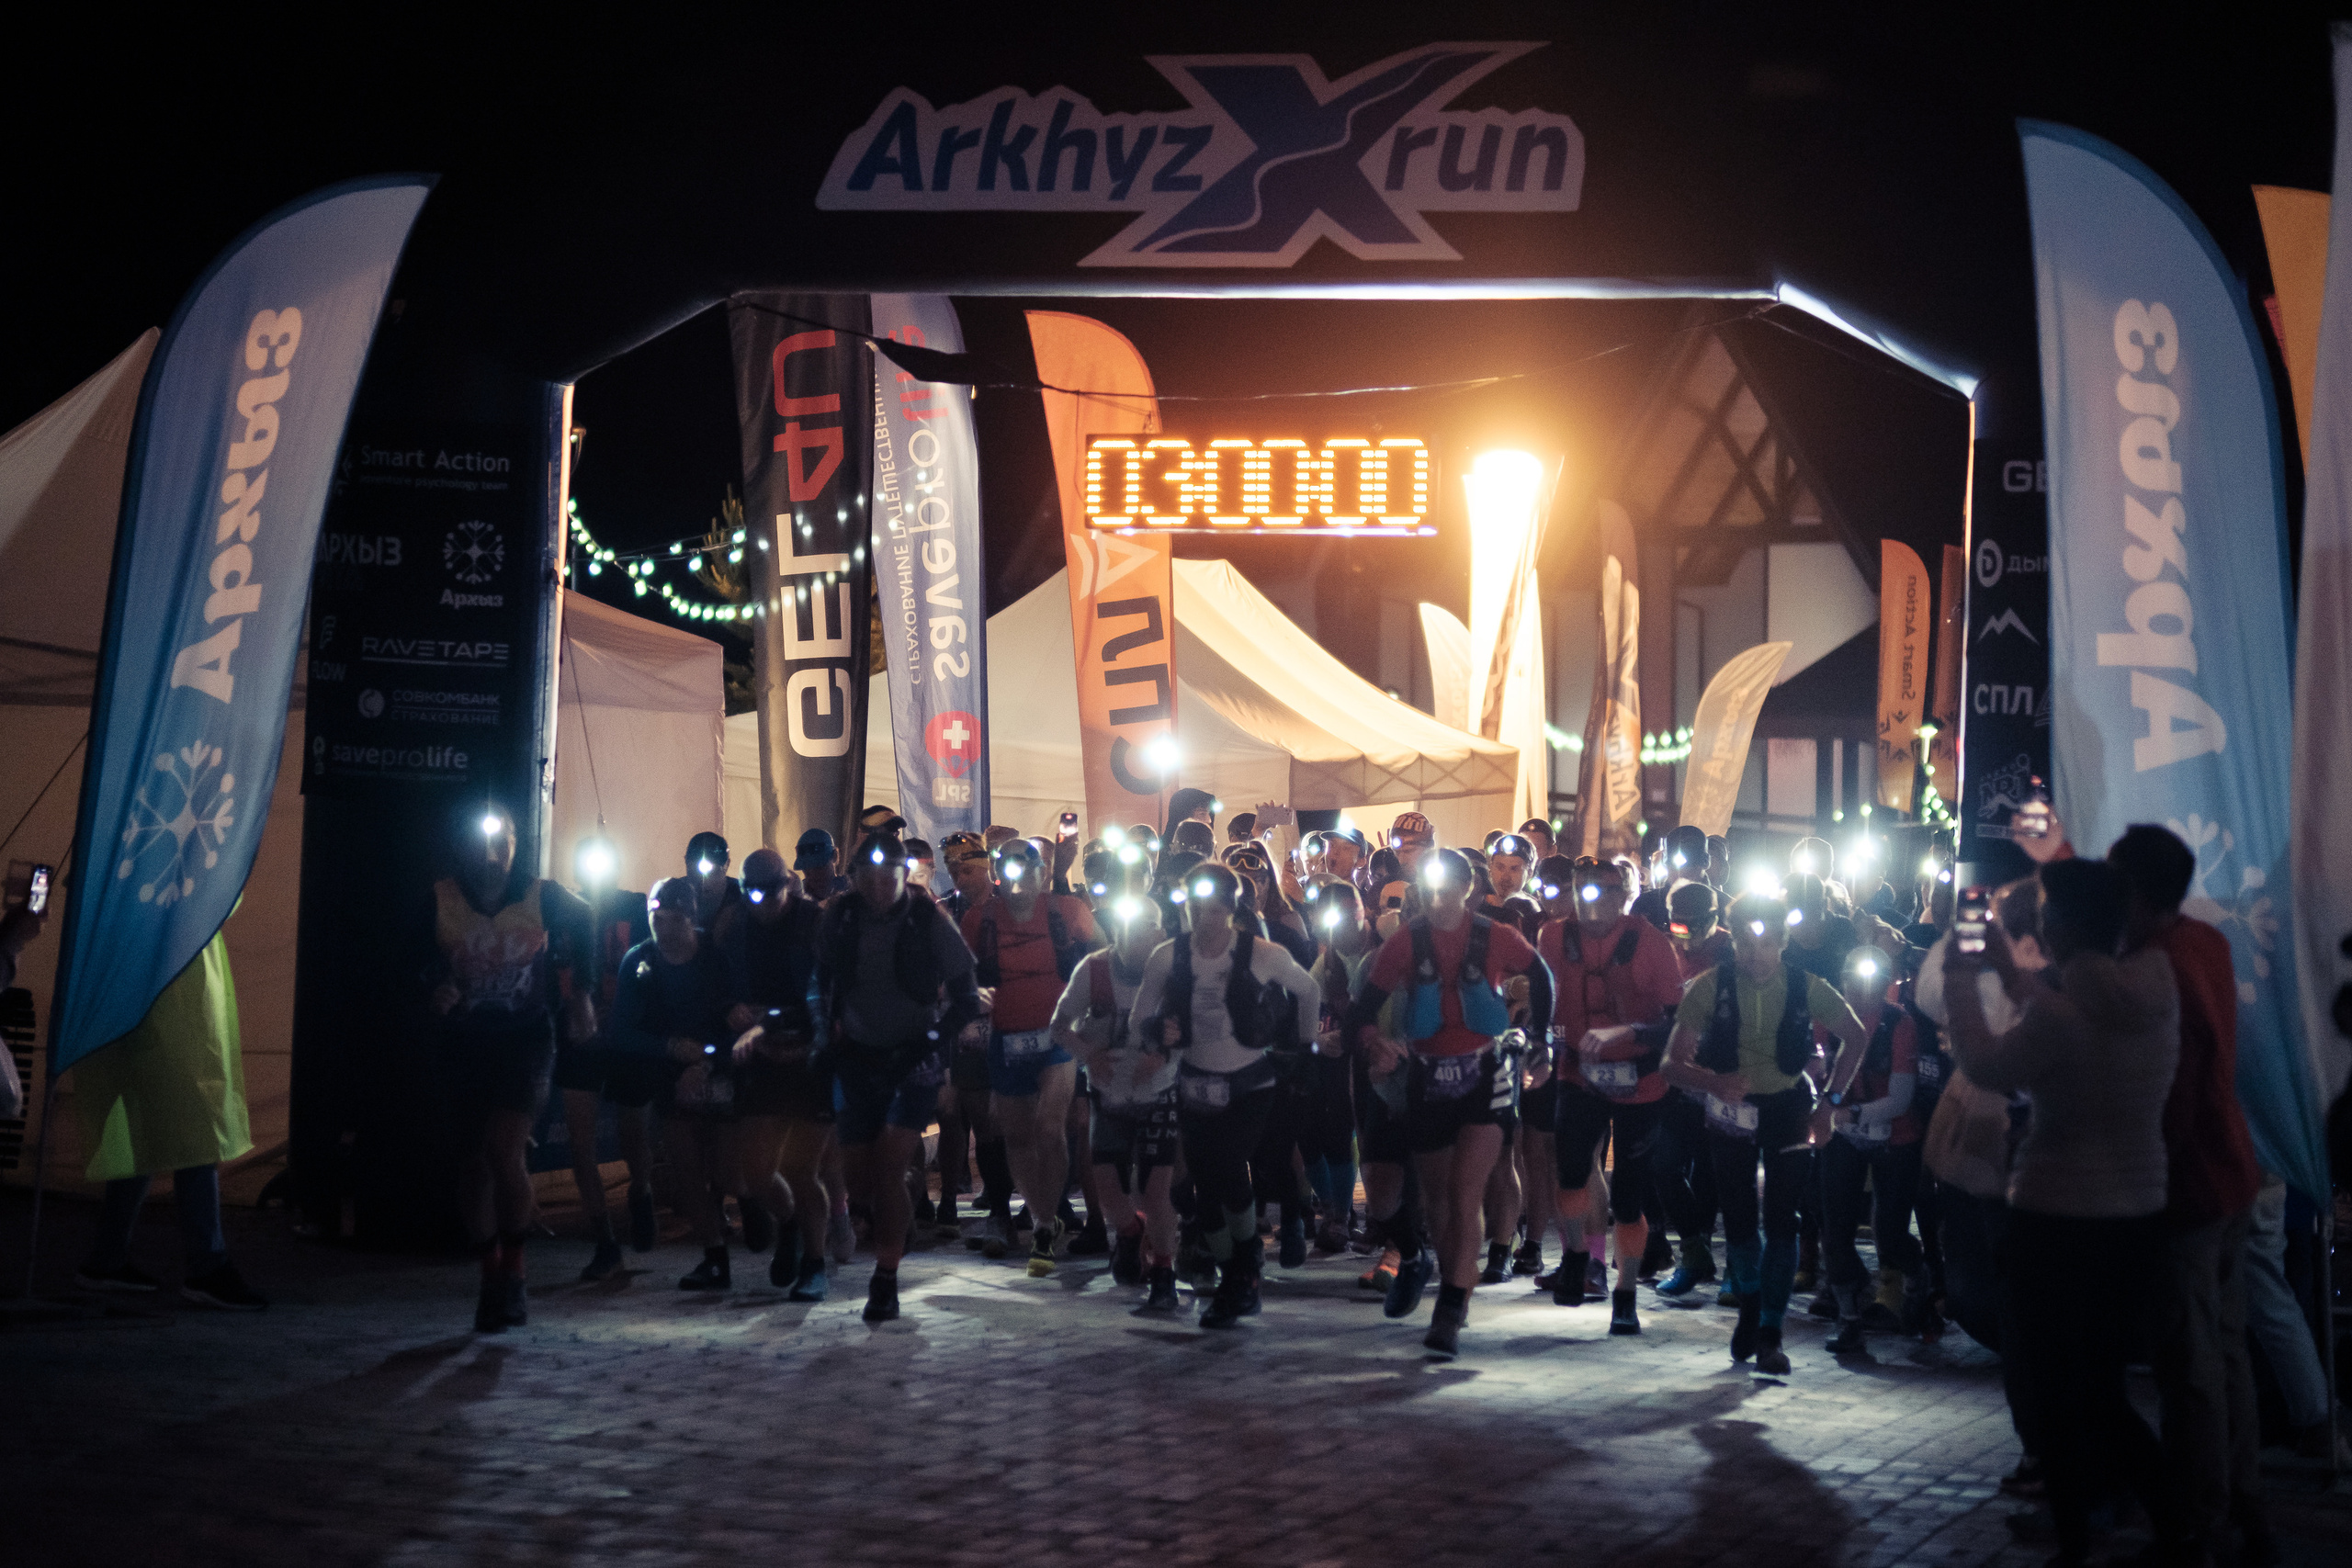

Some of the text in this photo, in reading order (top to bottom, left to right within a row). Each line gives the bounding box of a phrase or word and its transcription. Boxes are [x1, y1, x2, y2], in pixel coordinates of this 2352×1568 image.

[845, 96, 1216, 202] Arkhyz
[1384, 118, 1570, 194] run
[360, 445, 511, 473] Smart Action
[170, 306, 302, 705] Архыз
[361, 636, 509, 660] RAVETAPE
[332, 744, 469, 770] saveprolife
[1434, 1066, 1463, 1081] 401
